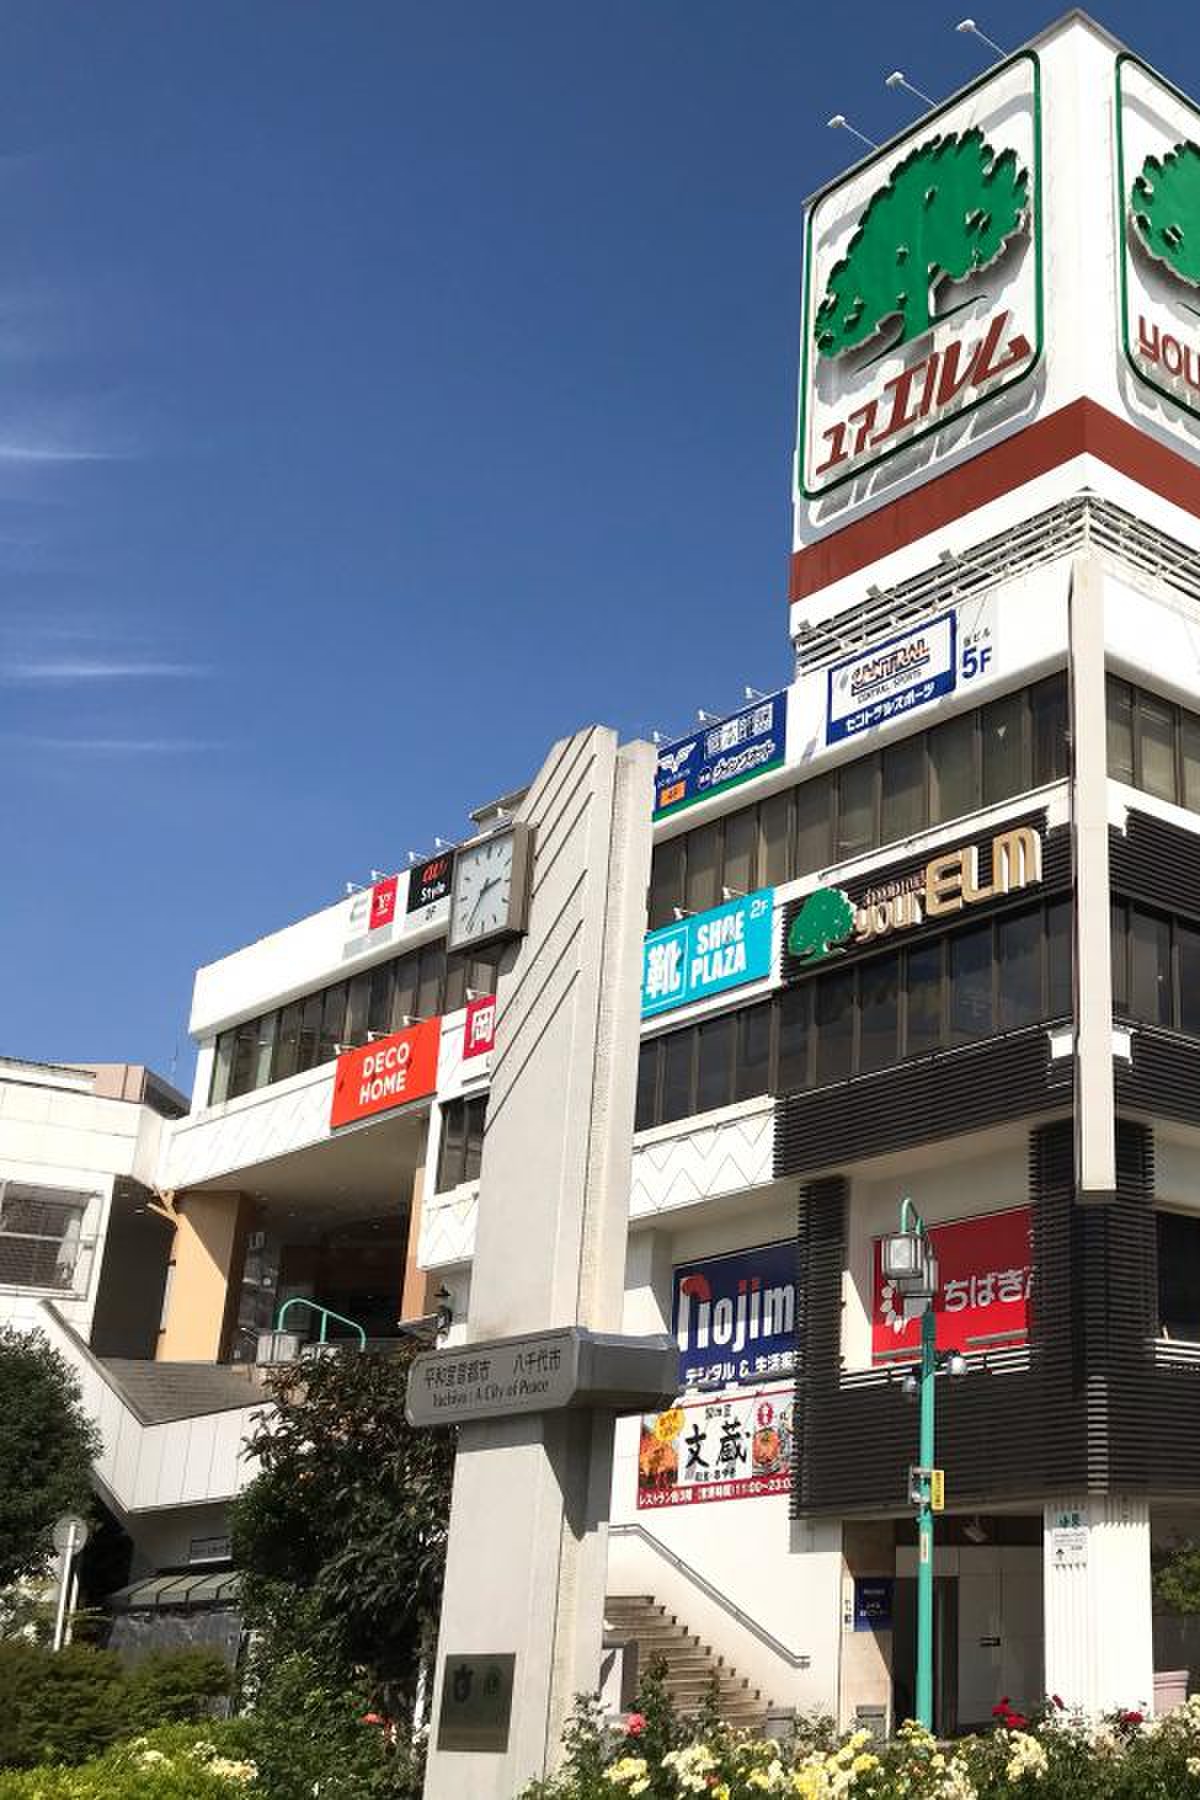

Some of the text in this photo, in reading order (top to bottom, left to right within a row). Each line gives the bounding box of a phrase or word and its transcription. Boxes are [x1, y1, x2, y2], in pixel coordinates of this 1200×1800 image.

[816, 310, 1031, 475] ユアエルム
[851, 638, 930, 688] CENTRAL
[962, 646, 992, 679] 5F
[750, 899, 769, 920] 2F
[697, 910, 745, 954] SHOE
[646, 940, 682, 998] 靴
[691, 941, 746, 989] PLAZA
[362, 1042, 410, 1078] DECO
[359, 1069, 407, 1104] HOME
[686, 1350, 802, 1384] デジタル & 生活家
